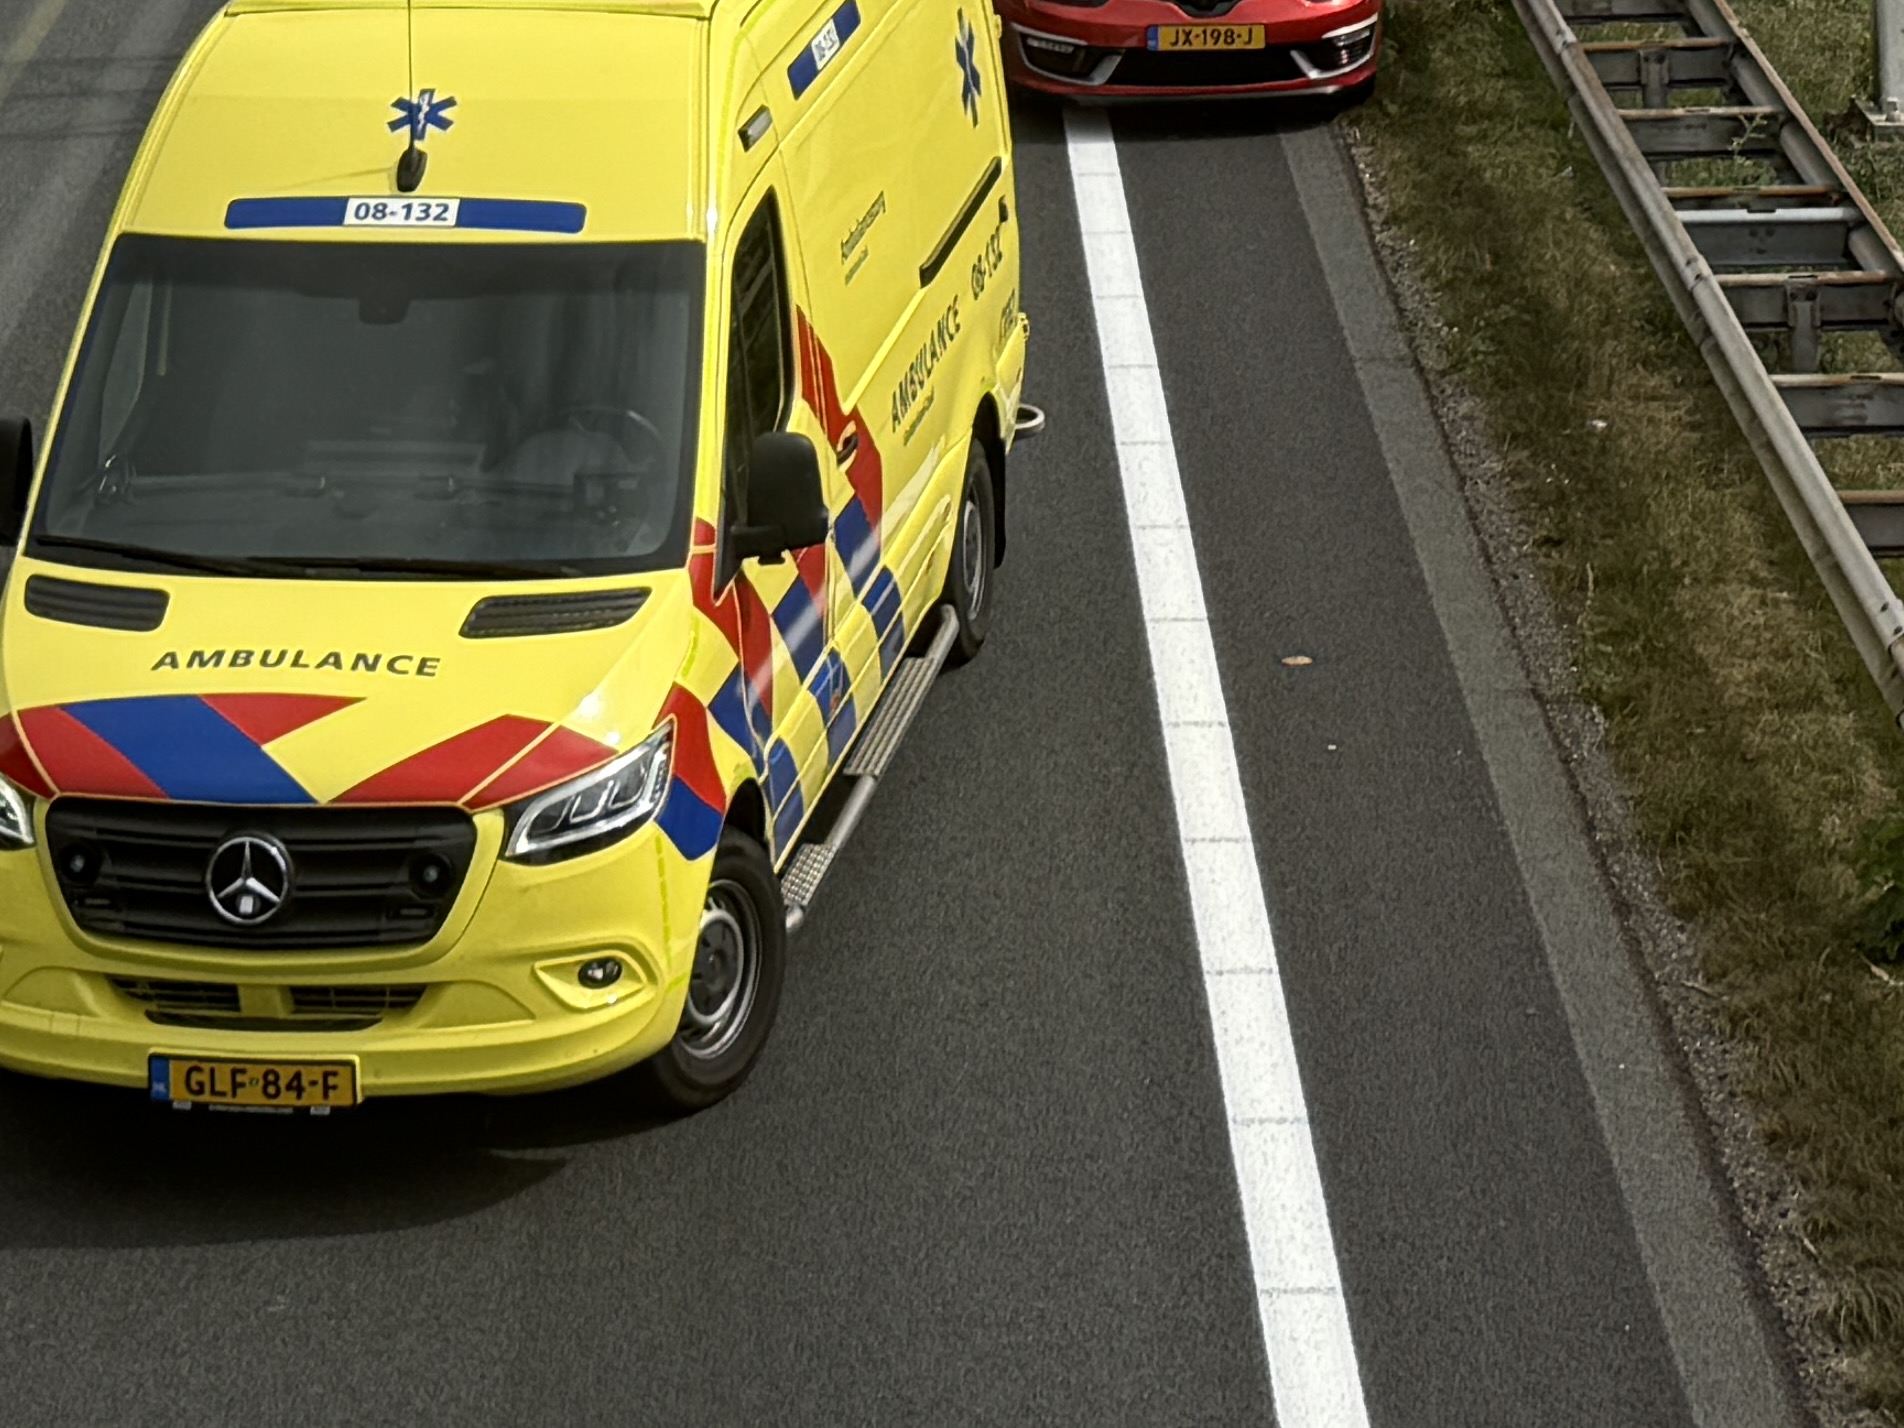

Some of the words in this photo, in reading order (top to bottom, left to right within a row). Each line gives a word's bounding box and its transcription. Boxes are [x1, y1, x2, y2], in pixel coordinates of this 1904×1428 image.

[1169, 27, 1253, 47] JX-198-J
[353, 201, 450, 223] 08-132
[891, 294, 962, 434] AMBULANCE
[150, 648, 442, 678] AMBULANCE
[184, 1064, 341, 1101] GLF-84-F
